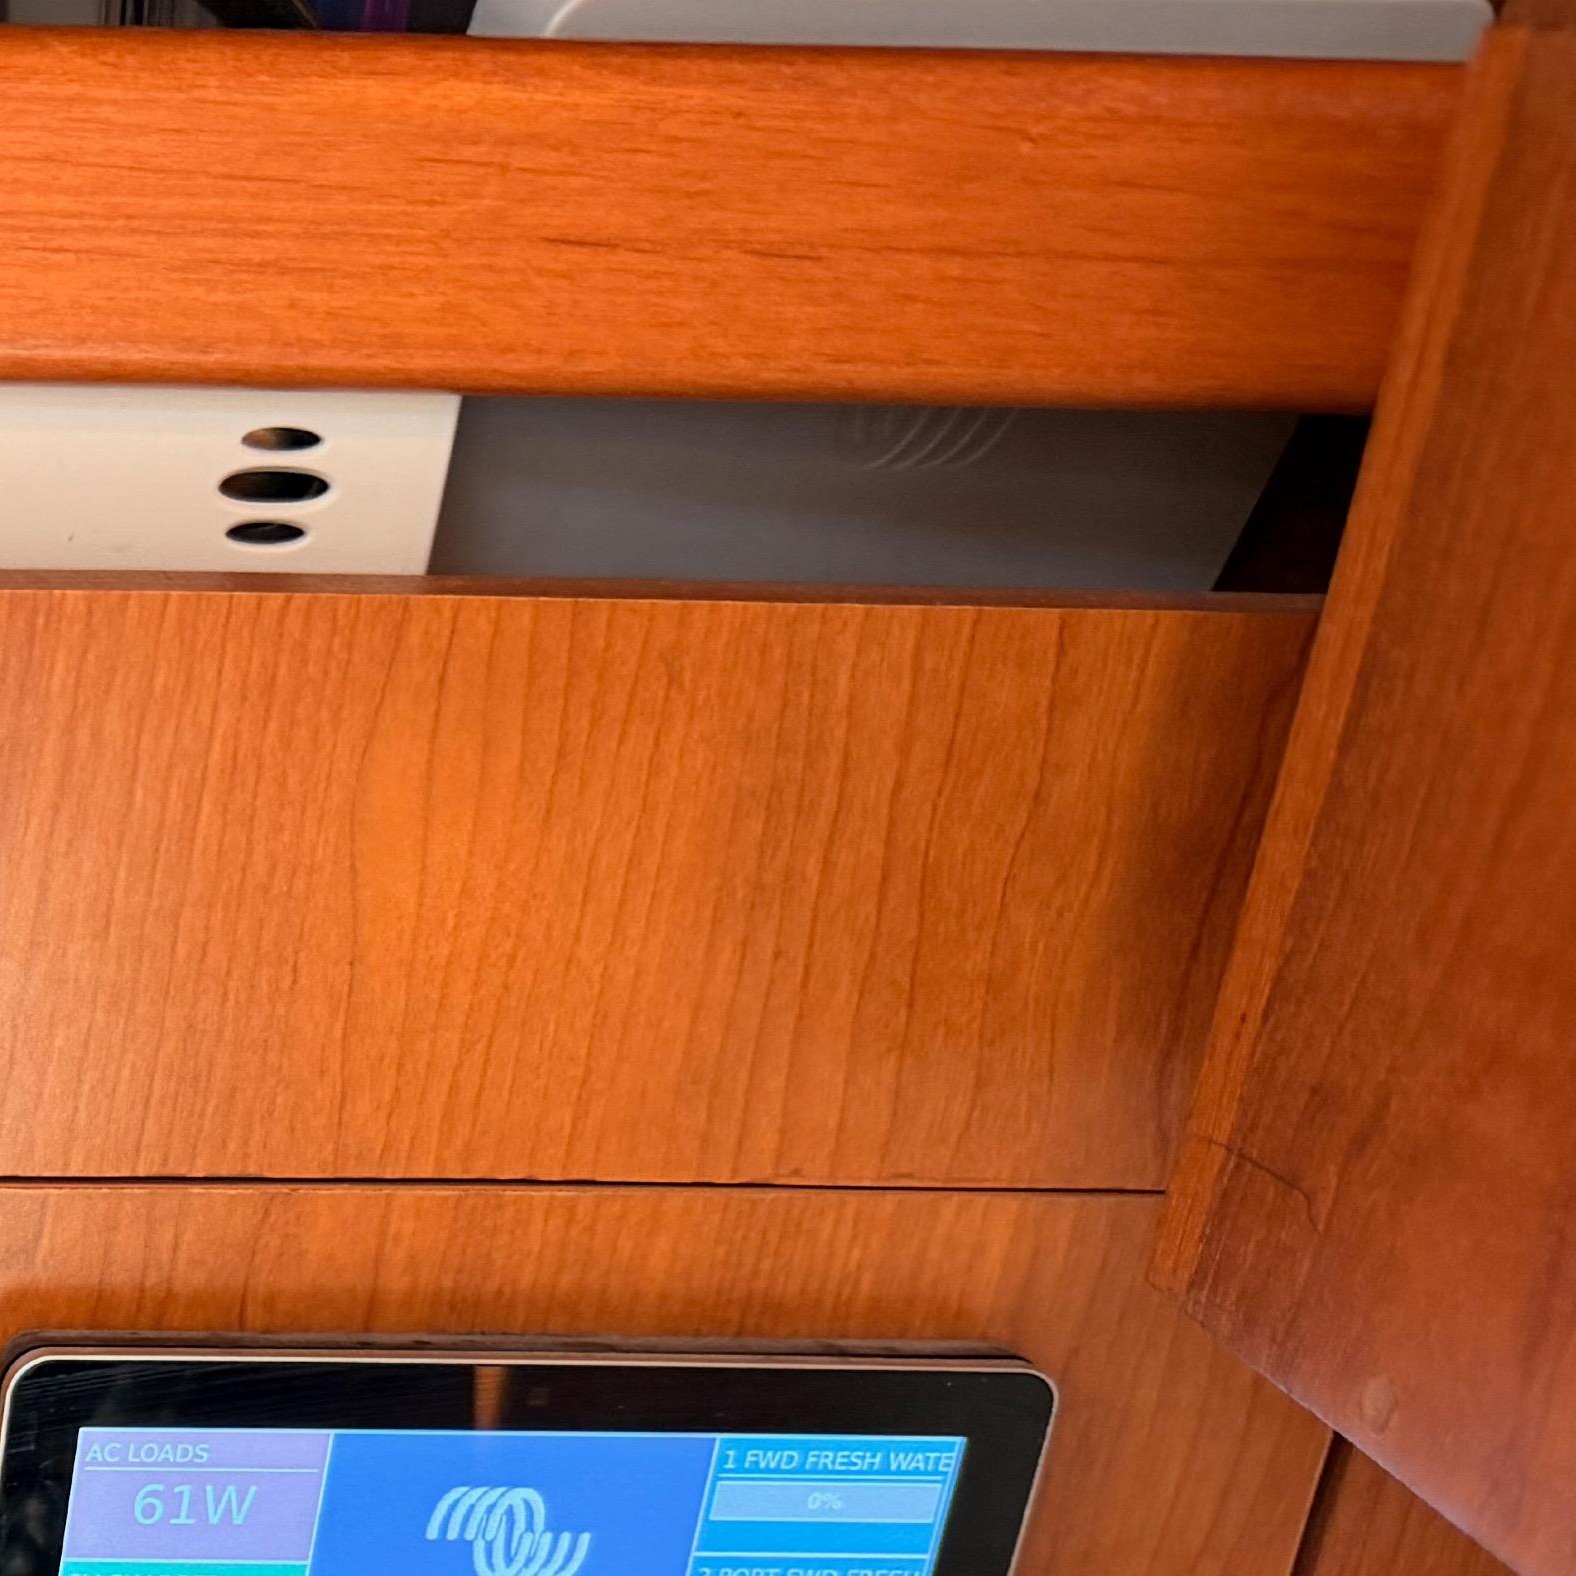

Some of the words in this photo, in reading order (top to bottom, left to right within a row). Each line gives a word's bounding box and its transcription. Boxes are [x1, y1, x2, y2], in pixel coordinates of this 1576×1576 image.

[85, 1443, 122, 1463] AC
[128, 1443, 209, 1463] LOADS
[723, 1450, 735, 1468] 1
[744, 1450, 798, 1470] FWD
[805, 1451, 882, 1471] FRESH
[134, 1483, 257, 1526] 61W
[807, 1492, 842, 1510] 0%
